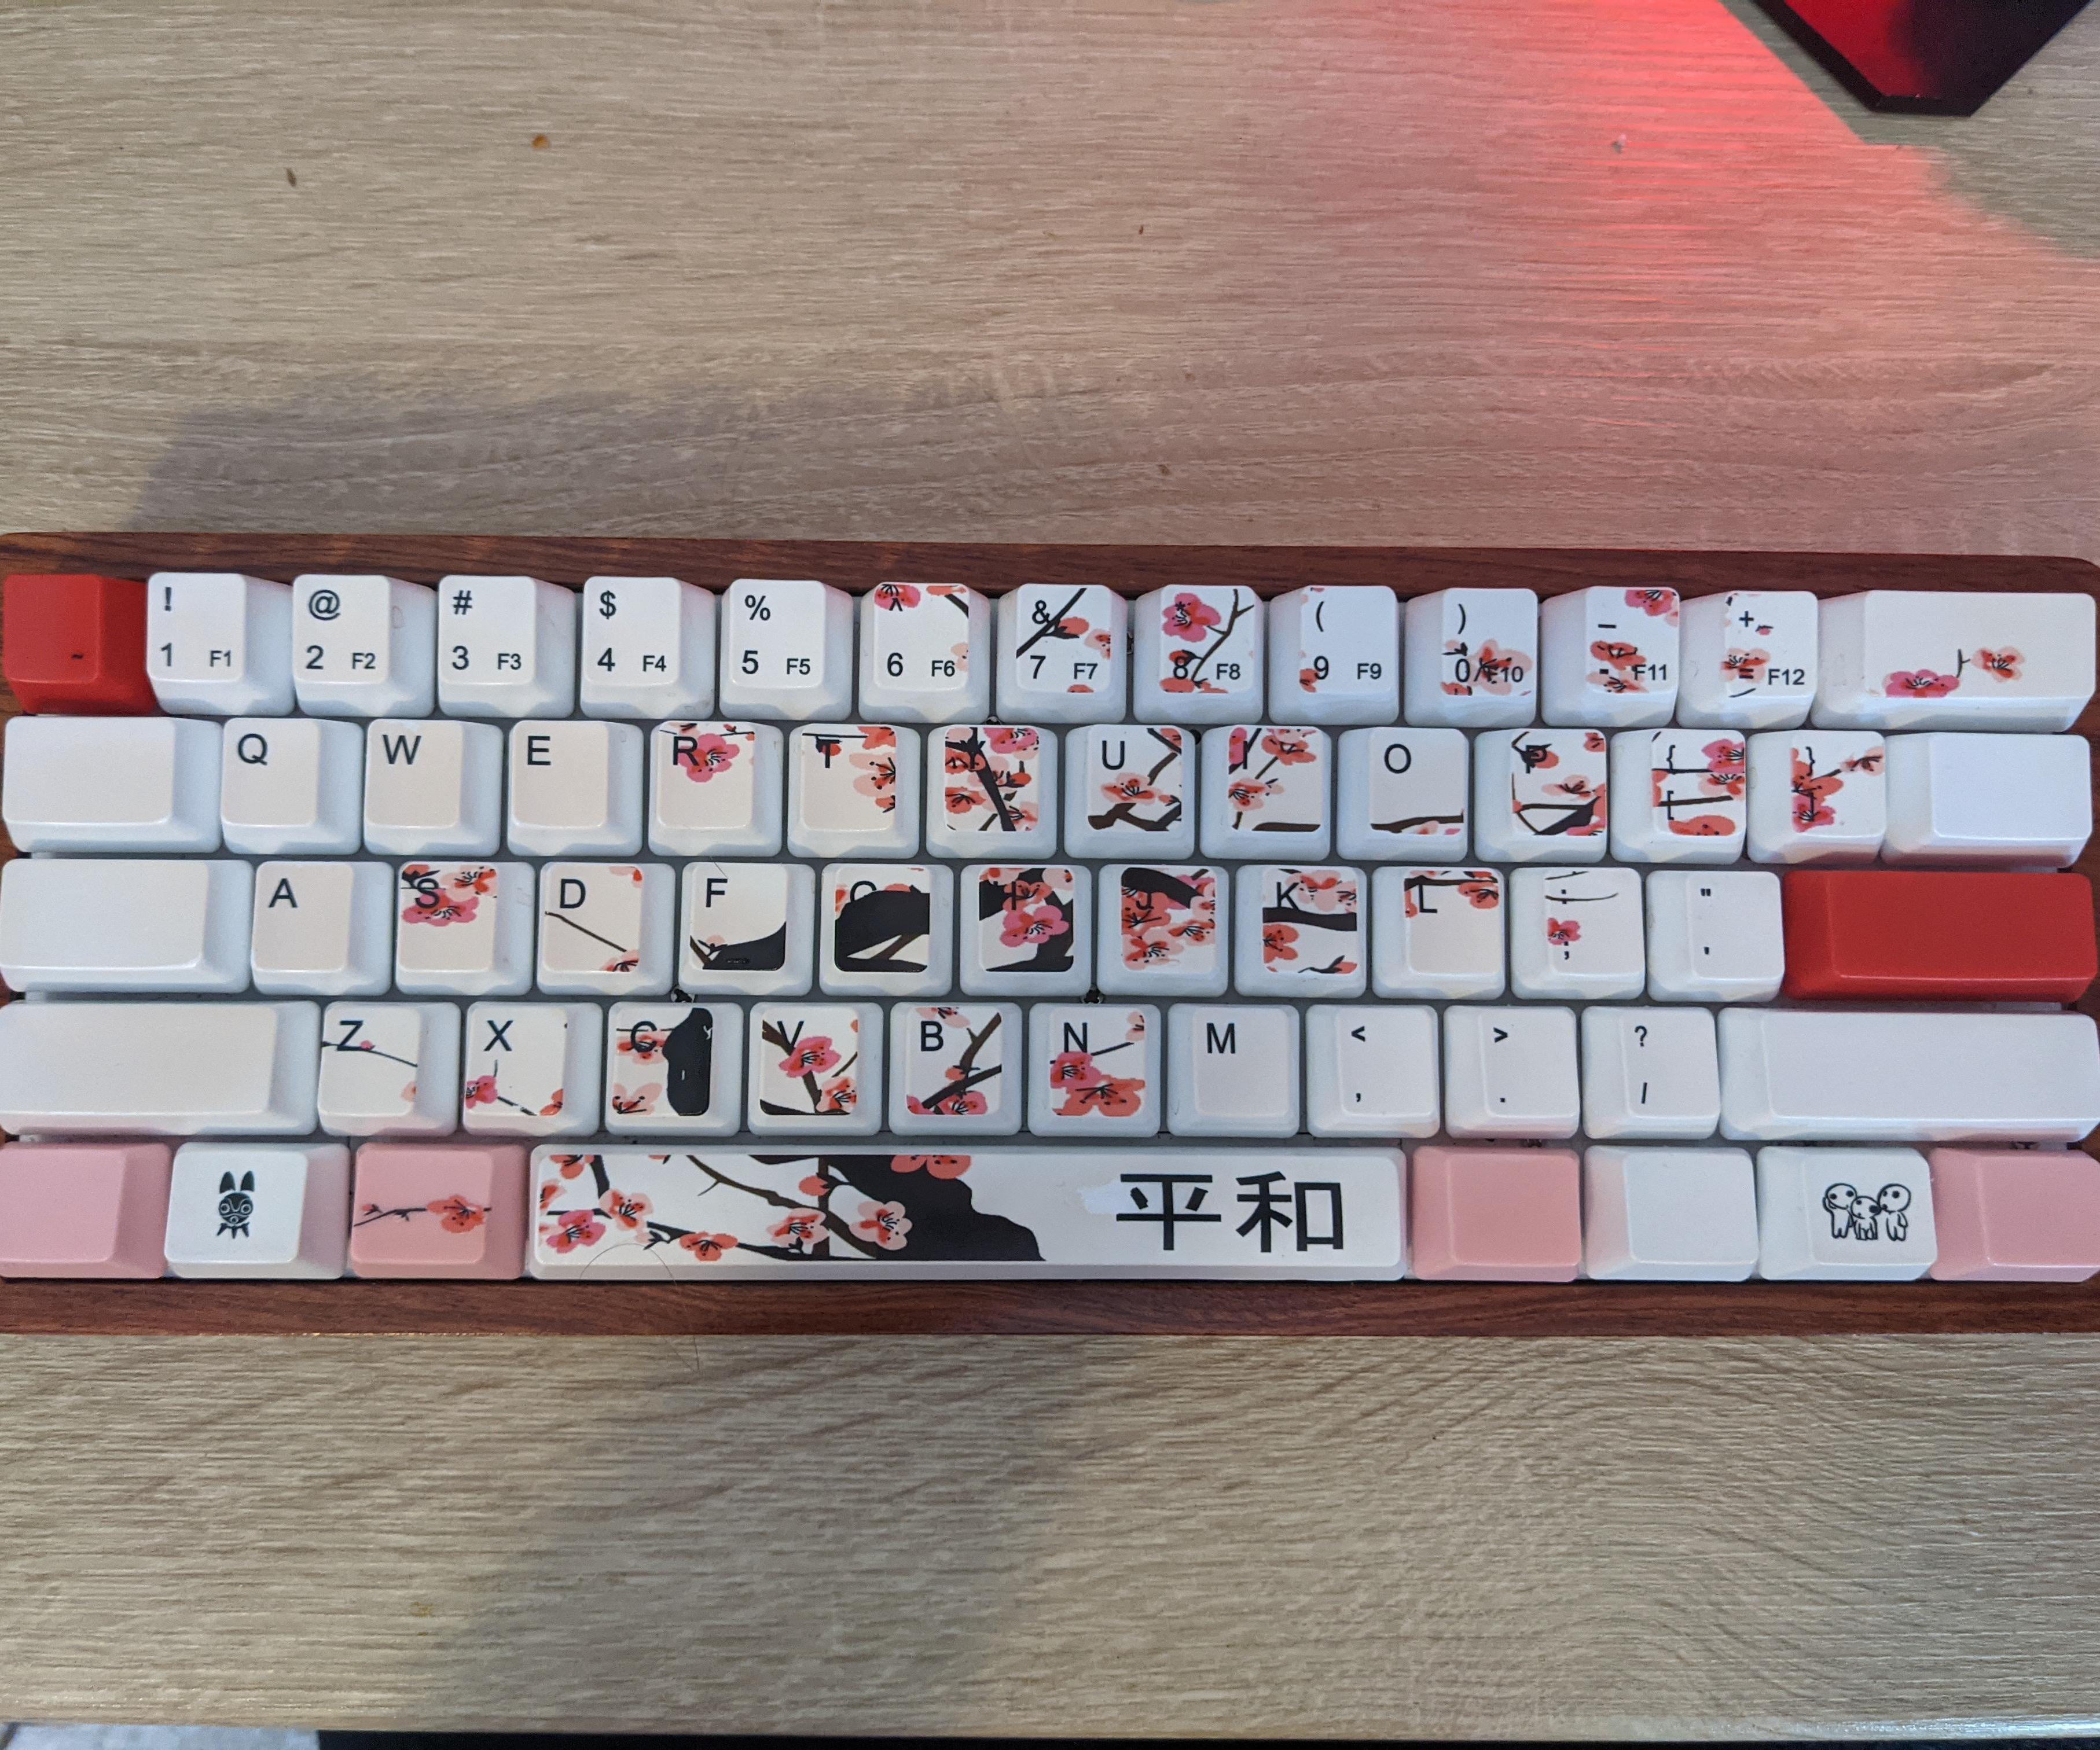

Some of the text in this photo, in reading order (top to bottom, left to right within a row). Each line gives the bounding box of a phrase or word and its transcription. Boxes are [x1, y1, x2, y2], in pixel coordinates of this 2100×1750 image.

[164, 587, 172, 611] !
[308, 590, 340, 621] @
[453, 590, 473, 615] #
[599, 590, 617, 620] $
[745, 595, 771, 622] %
[1032, 600, 1051, 624] &
[1316, 601, 1325, 632] (
[1457, 604, 1466, 634] )
[1739, 611, 1754, 627] +
[160, 643, 232, 668] 1 F1
[306, 645, 376, 670] 2 F2
[452, 646, 522, 671] 3 F3
[597, 647, 667, 672] 4 F4
[742, 650, 811, 676] 5 F5
[887, 653, 956, 678] 6 F6
[1030, 655, 1098, 680] 7 F7
[1173, 655, 1241, 681] 8 F8
[1313, 655, 1382, 681] 9 F9
[1455, 659, 1470, 682] 0
[1634, 664, 1668, 681] F11
[1739, 668, 1805, 686] = F12
[237, 733, 268, 766] Q
[383, 734, 421, 765] W
[528, 736, 551, 766] E
[673, 737, 699, 766] R
[815, 739, 840, 769] T
[1102, 740, 1125, 770] U
[1384, 744, 1412, 774] O
[269, 878, 298, 909] A
[414, 877, 440, 910] S
[560, 878, 586, 909] D
[707, 878, 728, 908] F
[1277, 881, 1299, 910] K
[1418, 884, 1438, 913] L
[336, 1020, 364, 1050] Z
[484, 1020, 513, 1052] X
[777, 1021, 804, 1052] V
[920, 1021, 945, 1052] B
[1064, 1022, 1088, 1053] N
[1207, 1023, 1236, 1054] M
[1351, 1025, 1366, 1043] <
[1493, 1027, 1509, 1044] >
[1634, 1025, 1648, 1047] ?
[1116, 1171, 1343, 1253] 平和
